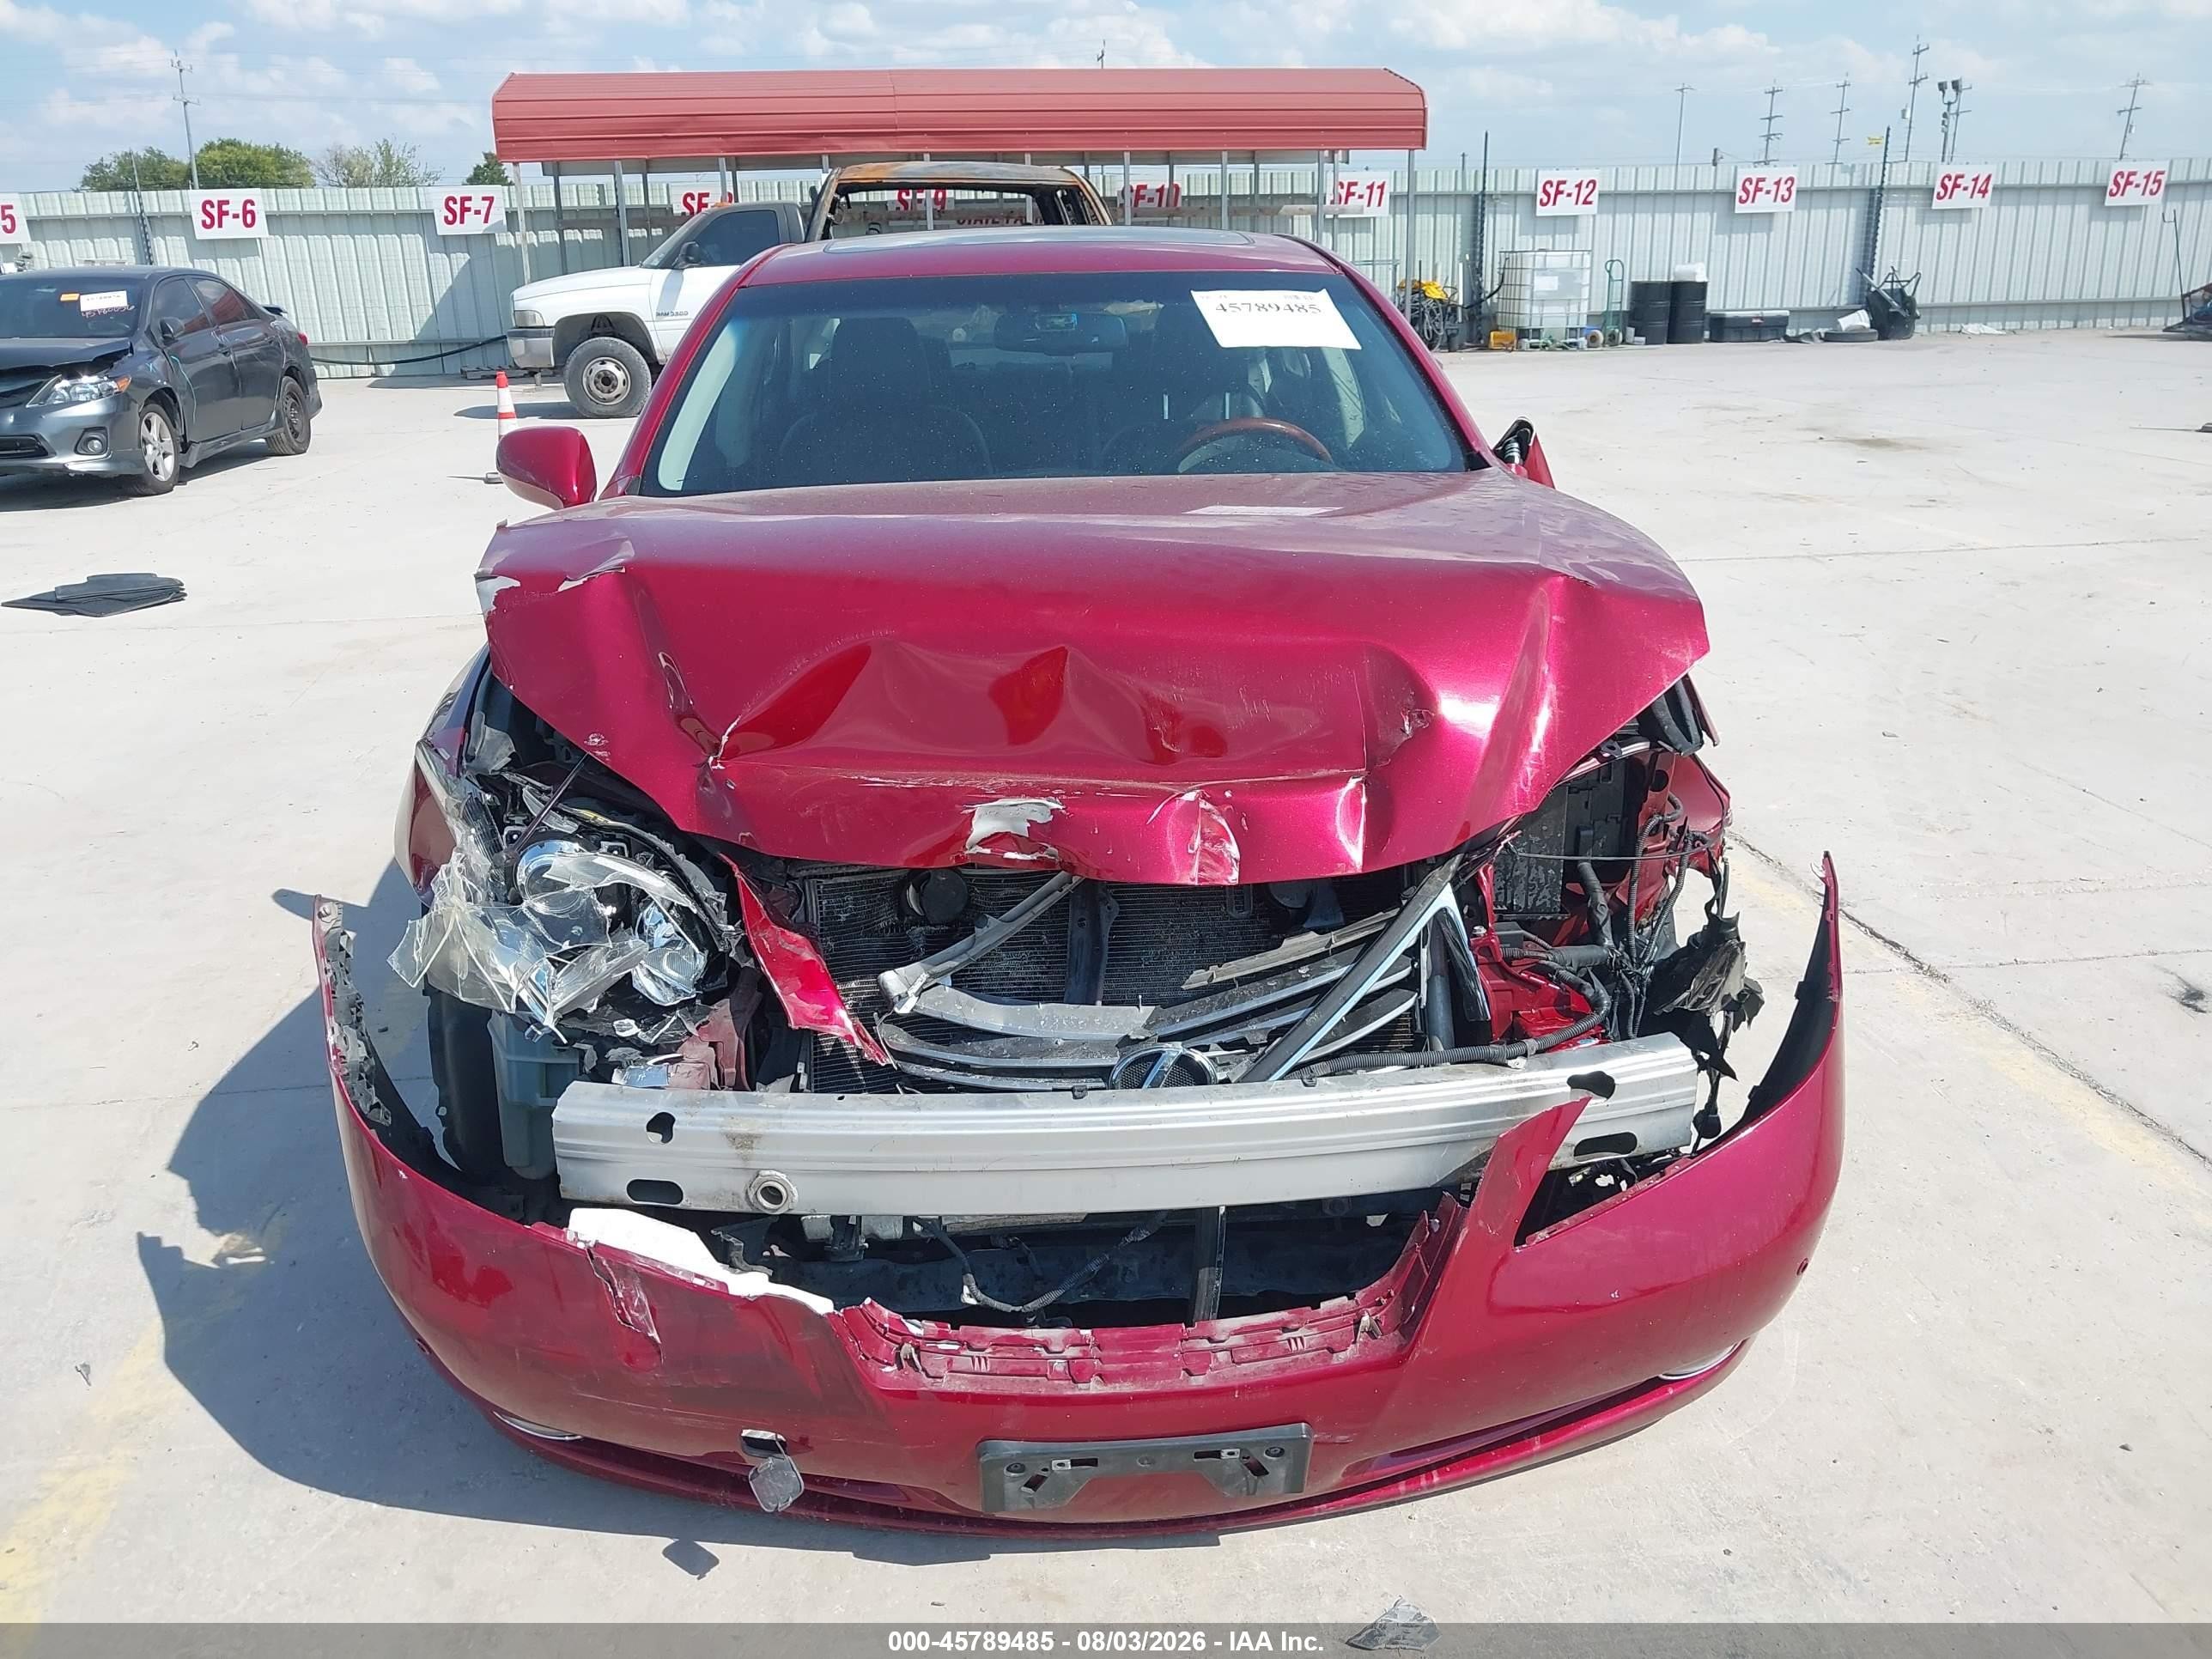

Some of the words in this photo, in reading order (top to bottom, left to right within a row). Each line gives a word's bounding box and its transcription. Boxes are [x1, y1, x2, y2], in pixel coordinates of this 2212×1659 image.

[1539, 179, 1597, 207] SF-12
[1738, 177, 1796, 204] SF-13
[1936, 174, 1992, 201] SF-14
[2109, 171, 2166, 197] SF-15
[201, 198, 257, 229] SF-6
[443, 195, 495, 225] SF-7
[1215, 302, 1322, 314] 45789485
